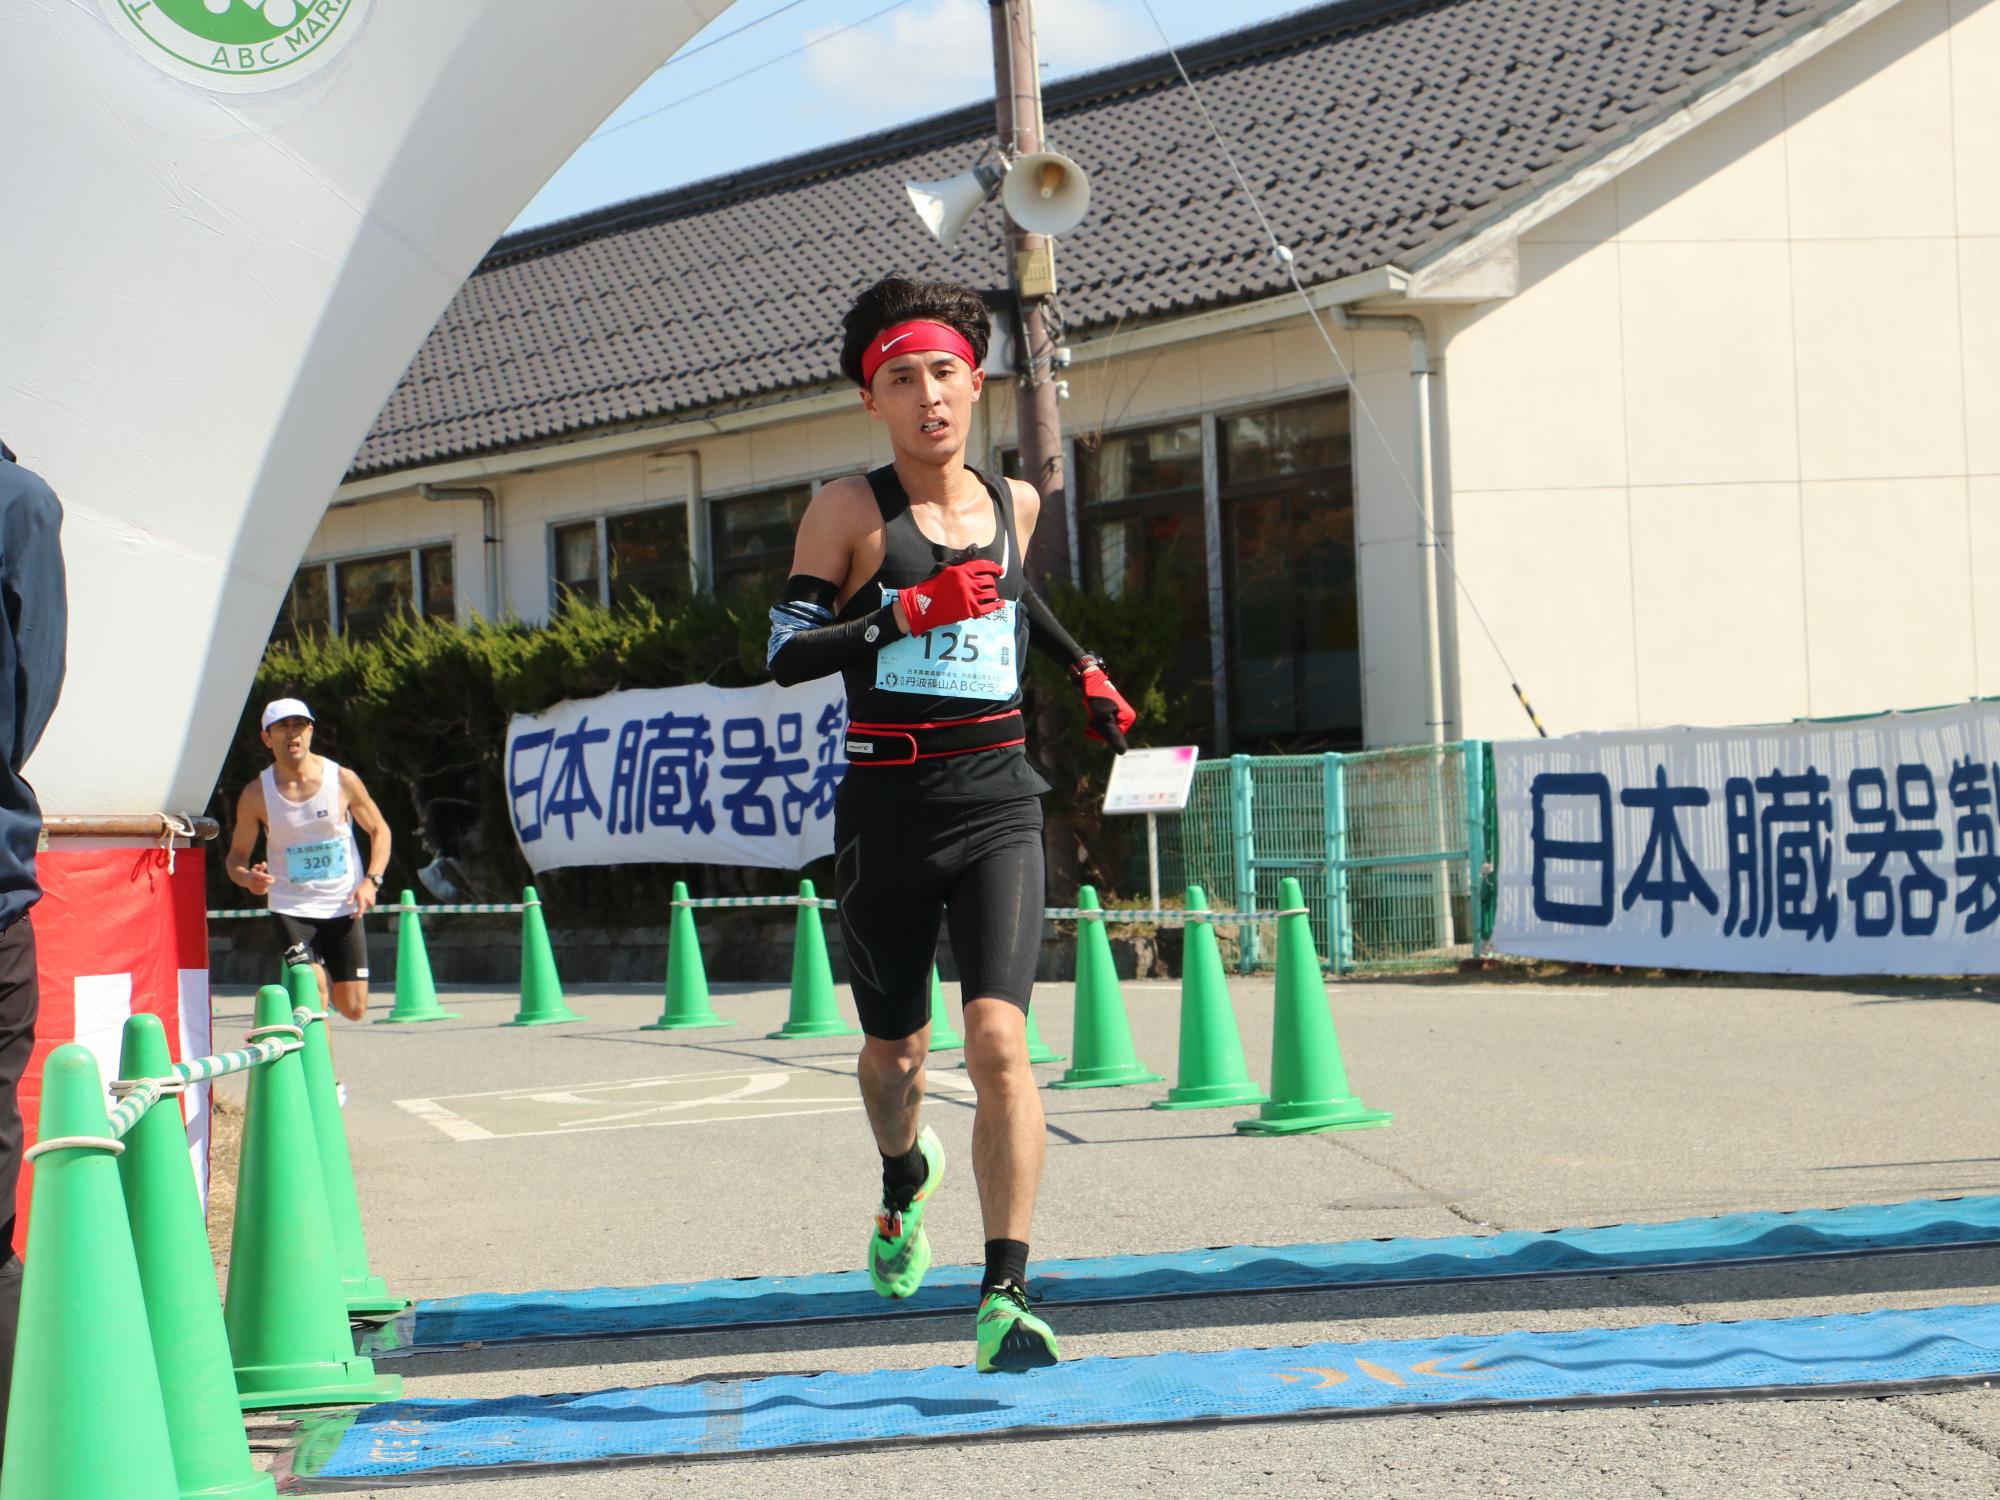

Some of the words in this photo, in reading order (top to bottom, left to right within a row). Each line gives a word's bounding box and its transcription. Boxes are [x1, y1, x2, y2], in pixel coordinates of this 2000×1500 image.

[210, 42, 280, 69] ABC
[284, 0, 342, 53] MAR
[920, 630, 979, 663] 125
[303, 855, 331, 869] 320
